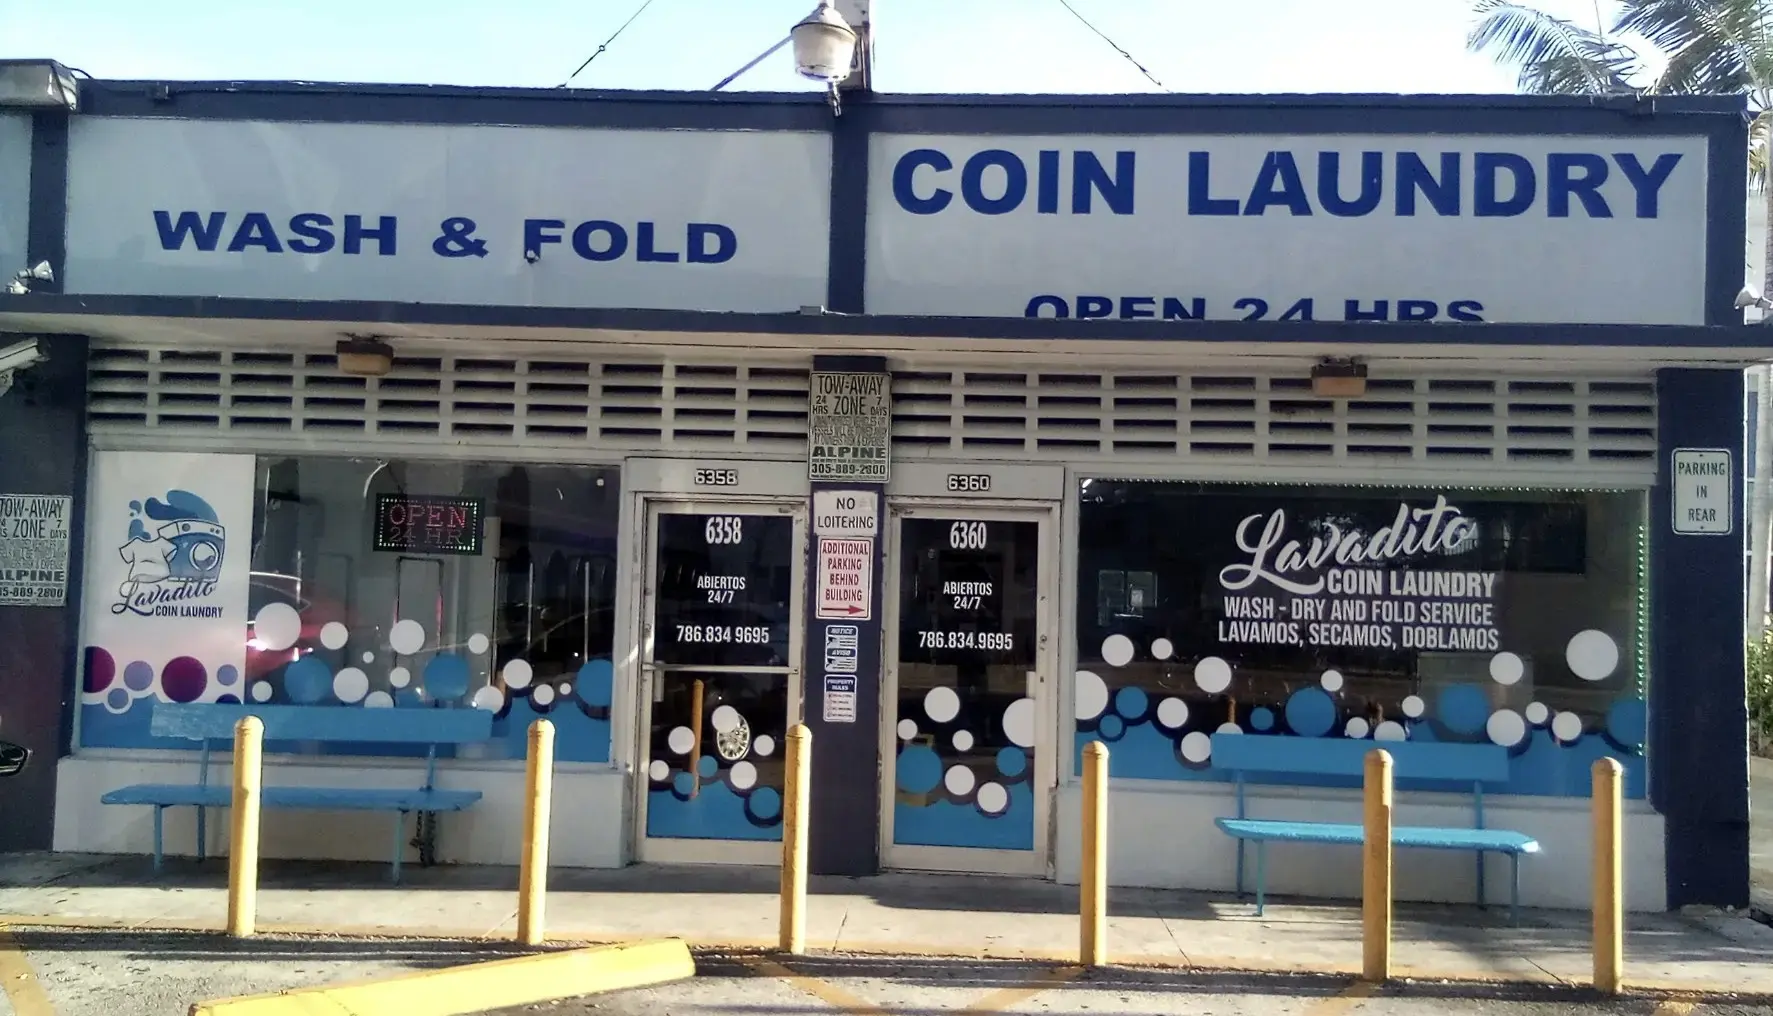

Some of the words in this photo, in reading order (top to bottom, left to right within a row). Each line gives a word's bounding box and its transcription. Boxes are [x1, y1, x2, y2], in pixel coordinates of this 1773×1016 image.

[893, 148, 1136, 216] COIN
[1187, 150, 1683, 220] LAUNDRY
[153, 210, 398, 256] WASH
[432, 217, 489, 259] &
[525, 219, 739, 265] FOLD
[1025, 295, 1206, 321] OPEN
[1344, 300, 1484, 322] HRS
[818, 375, 884, 395] TOW-AWAY
[812, 405, 828, 414] HRS
[870, 406, 887, 416] DAYS
[816, 395, 826, 404] 24
[833, 396, 866, 415] ZONE
[876, 397, 882, 405] 7
[812, 446, 886, 458] ALPINE
[695, 469, 738, 485] 6358
[811, 463, 886, 475] 305-889-2800
[1678, 462, 1726, 476] PARKING
[948, 475, 990, 491] 6360
[1696, 485, 1708, 498] IN
[836, 498, 856, 510] NO
[389, 504, 468, 529] OPEN
[818, 516, 874, 528] LOITERING
[1688, 508, 1716, 522] REAR
[13, 520, 46, 539] ZONE
[56, 520, 63, 529] 7
[50, 530, 68, 539] DAYS
[389, 526, 416, 543] 24
[425, 528, 464, 545] HR
[705, 516, 742, 545] 6358
[950, 521, 987, 549] 6360
[822, 543, 868, 555] ADDITIONAL
[1219, 494, 1478, 595] Lavadito
[828, 558, 862, 570] PARKING
[697, 575, 746, 590] ABIERTOS
[830, 573, 859, 586] BEHIND
[1327, 569, 1382, 596] COIN
[1390, 570, 1496, 598] LAUNDRY
[825, 589, 862, 601] BUILDING
[943, 581, 993, 596] ABIERTOS
[111, 578, 216, 616] Lavadito
[707, 590, 735, 604] 24/7
[953, 596, 981, 610] 24/7
[155, 605, 178, 617] COIN
[180, 606, 224, 618] LAUNDRY
[1224, 596, 1274, 620] WASH
[1292, 598, 1325, 621] DRY
[1331, 600, 1366, 623] AND
[1371, 601, 1415, 624] FOLD
[1420, 602, 1493, 626] SERVICE
[735, 627, 770, 644] 9695
[918, 631, 1013, 650] 786.834.9695
[1218, 620, 1303, 648] LAVAMOS,
[1308, 624, 1397, 650] SECAMOS,
[1402, 626, 1499, 650] DOBLAMOS
